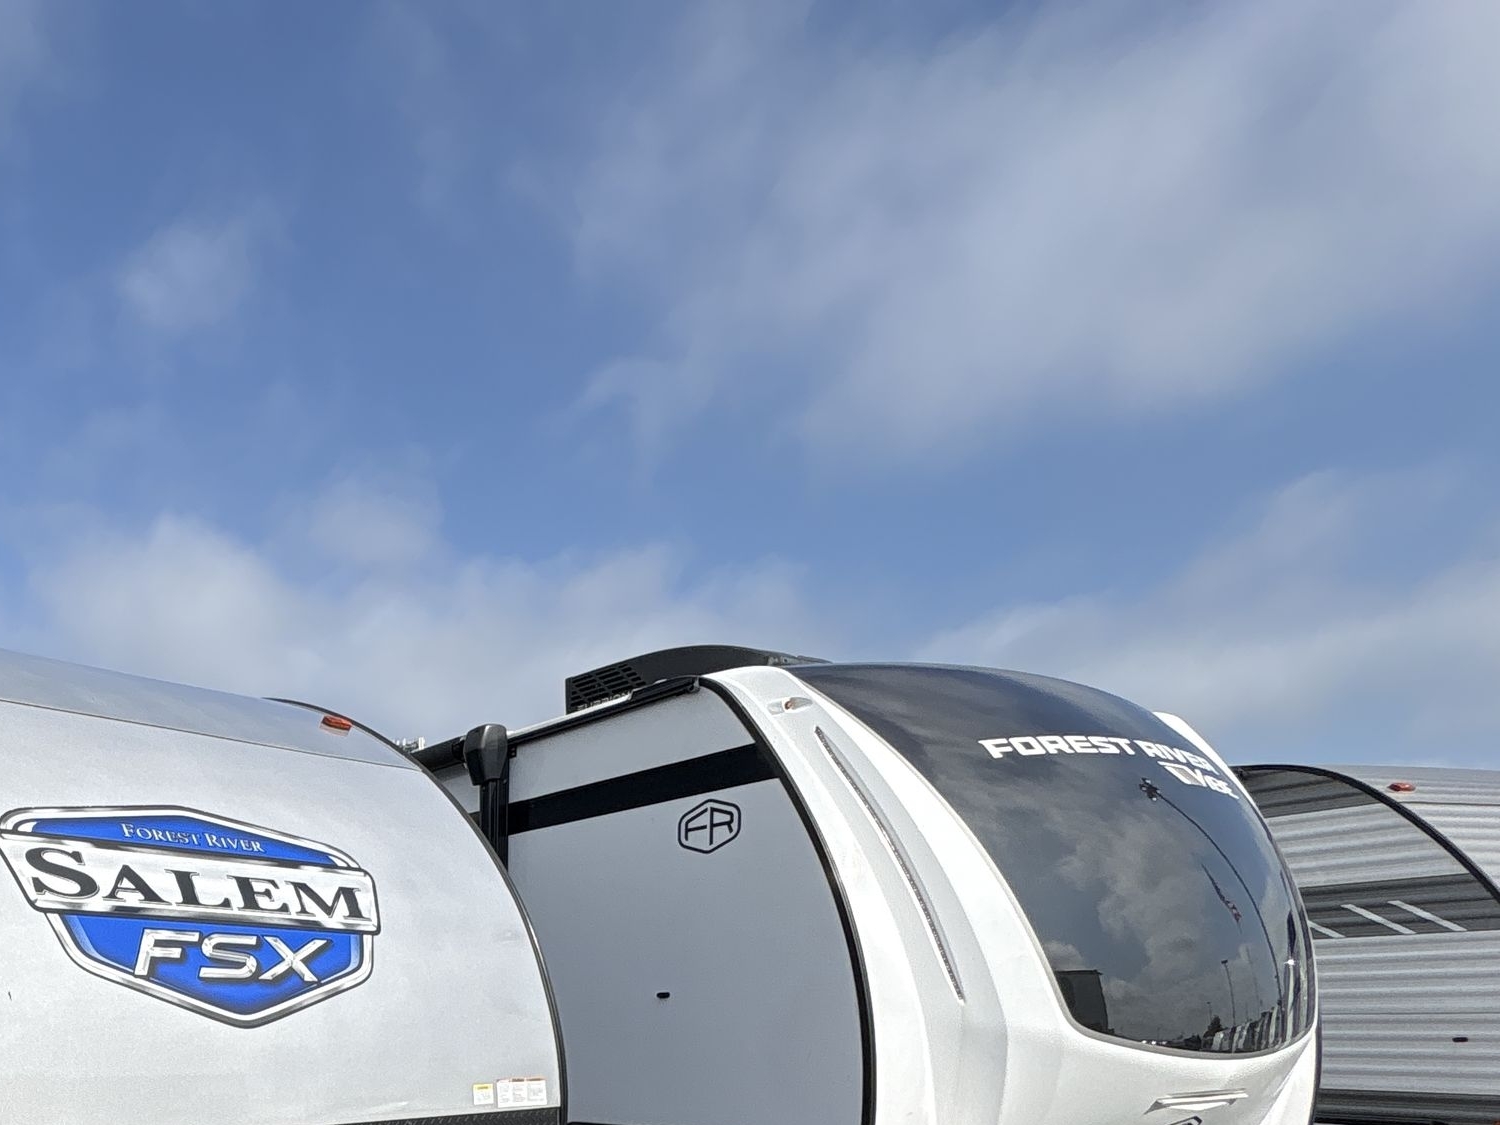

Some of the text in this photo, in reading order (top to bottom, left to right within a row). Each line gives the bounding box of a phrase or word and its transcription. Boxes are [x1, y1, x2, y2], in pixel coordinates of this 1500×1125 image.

[978, 735, 1220, 776] FOREST RIVER
[120, 822, 265, 852] FOREST RIVER
[24, 846, 373, 922] SALEM
[133, 926, 329, 984] FSX
